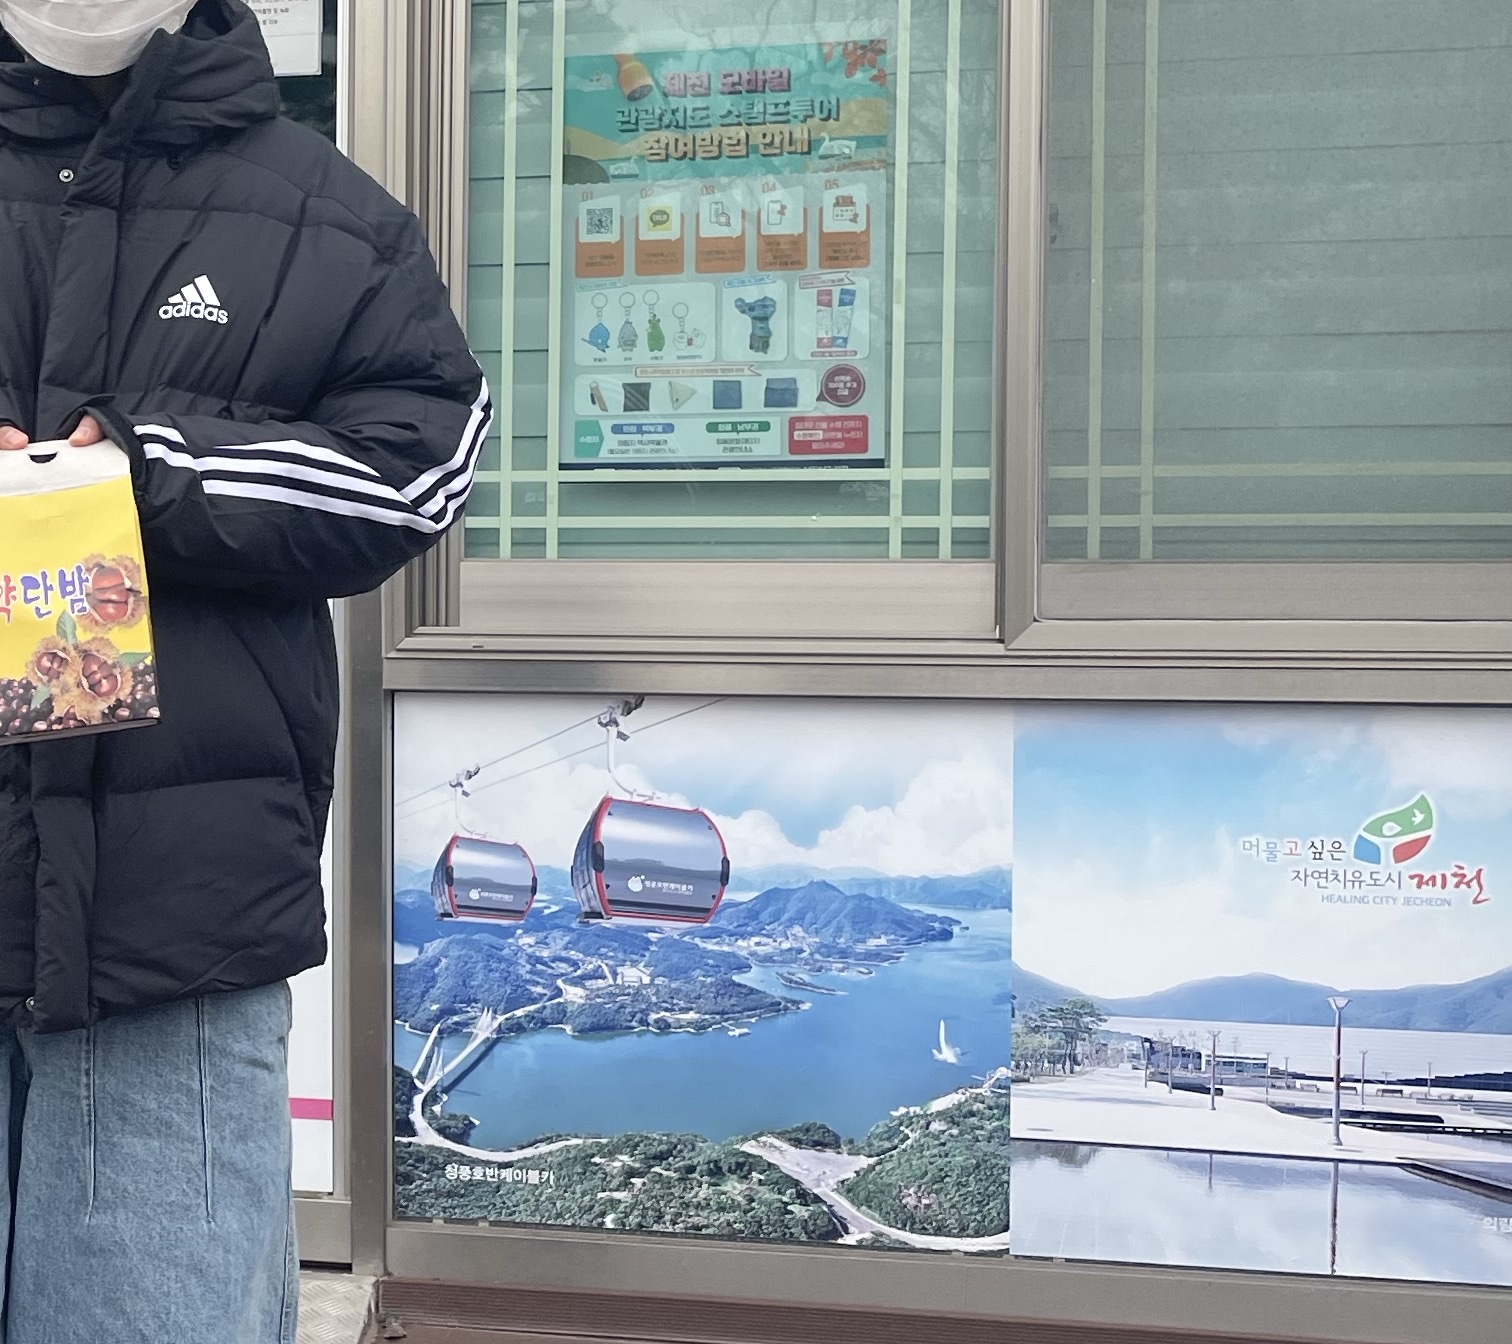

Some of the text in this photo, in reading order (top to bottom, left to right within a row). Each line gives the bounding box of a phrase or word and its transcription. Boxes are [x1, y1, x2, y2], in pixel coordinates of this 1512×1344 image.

[664, 67, 791, 97] 제천 모바일
[616, 97, 840, 133] 관광지도 스탬프투어
[643, 126, 813, 162] 참여방법 안내
[640, 187, 654, 199] 02
[824, 178, 840, 191] 05
[158, 301, 229, 325] adidas
[1242, 837, 1347, 863] 머물고 싶은
[1291, 864, 1490, 905] 자연치유도시 제천
[1321, 893, 1453, 907] HEALING CITY JECHEON
[444, 1162, 555, 1185] 청풍호반케이블카
